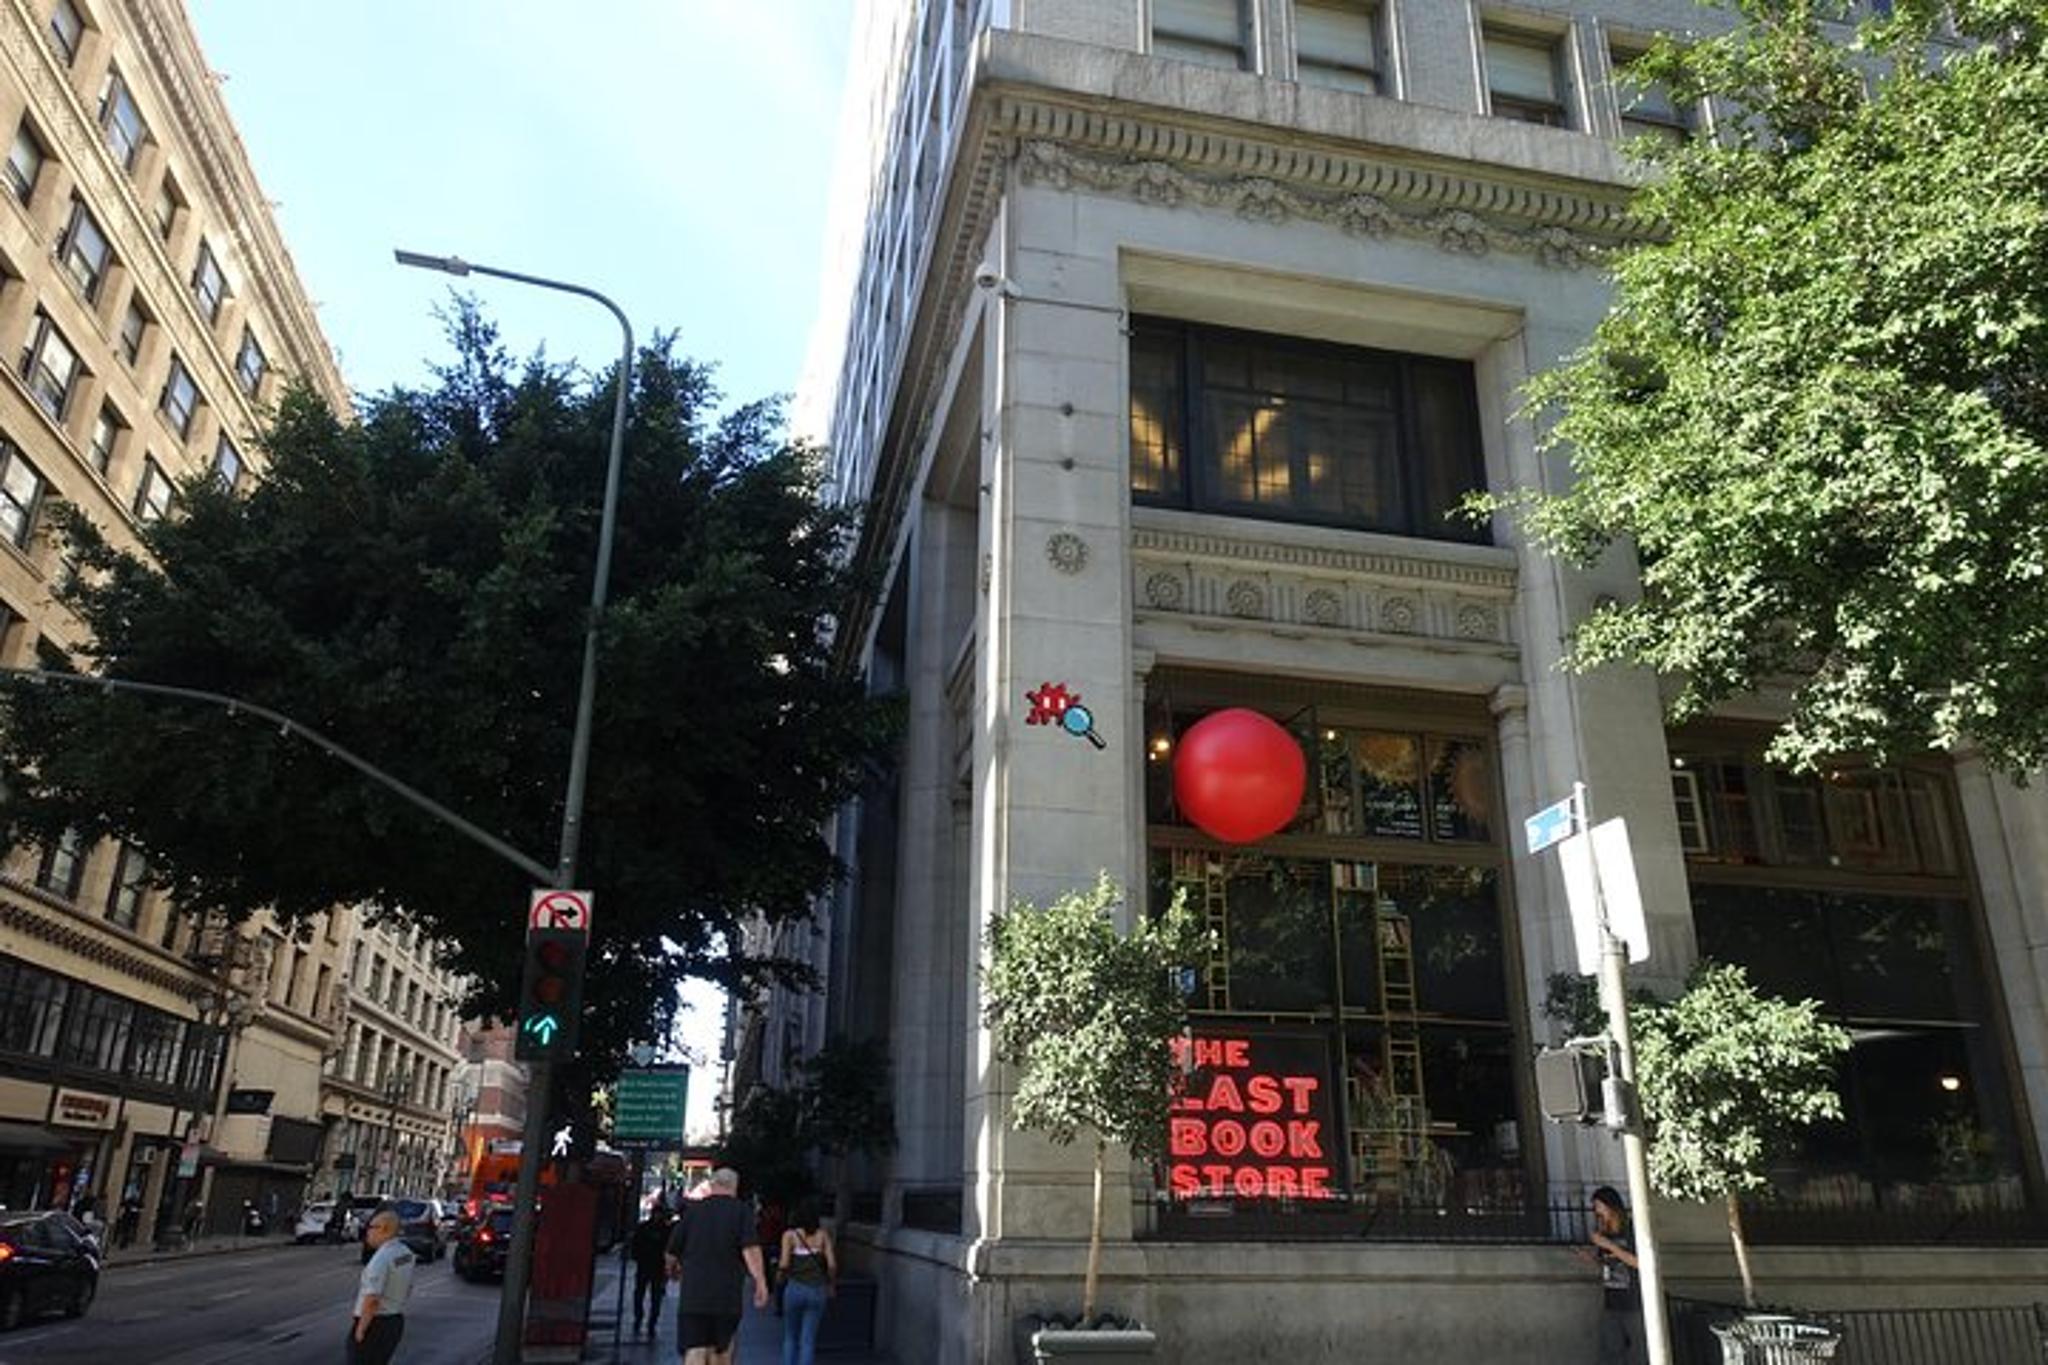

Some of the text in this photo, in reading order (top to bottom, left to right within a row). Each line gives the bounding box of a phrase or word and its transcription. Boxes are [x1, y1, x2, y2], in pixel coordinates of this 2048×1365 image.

[1168, 1037, 1250, 1067] THE
[1171, 1118, 1323, 1158] BOOK
[1171, 1163, 1331, 1198] STORE
